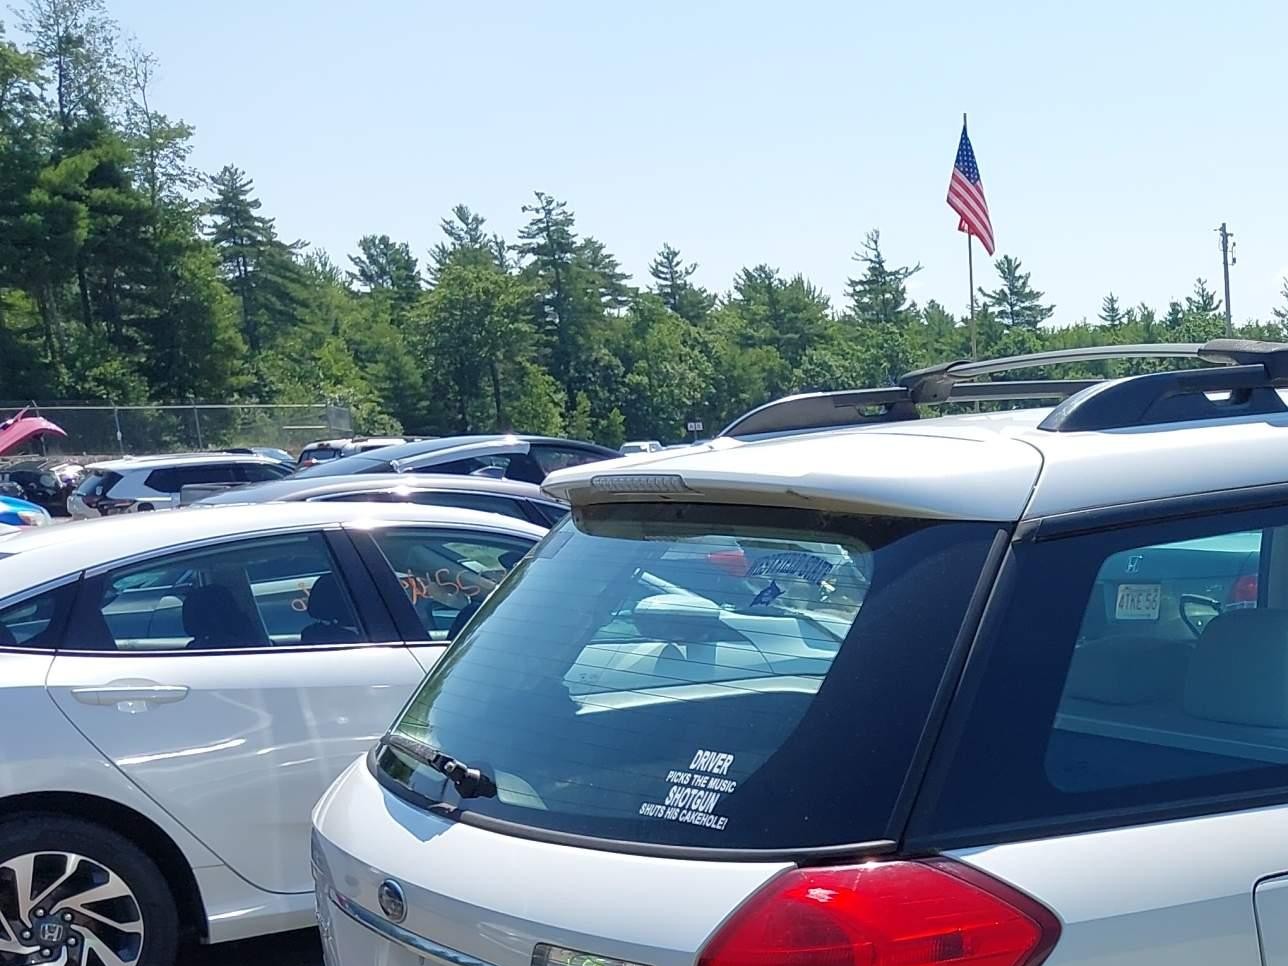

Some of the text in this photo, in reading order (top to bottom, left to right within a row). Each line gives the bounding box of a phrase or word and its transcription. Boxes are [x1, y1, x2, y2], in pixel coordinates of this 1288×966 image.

[689, 749, 734, 775] DRIVER
[665, 770, 737, 793] PICKS THE MUSIC
[664, 785, 720, 813] SHOTGUN
[639, 802, 729, 831] SHUTS HIS CAKEHOLE!
